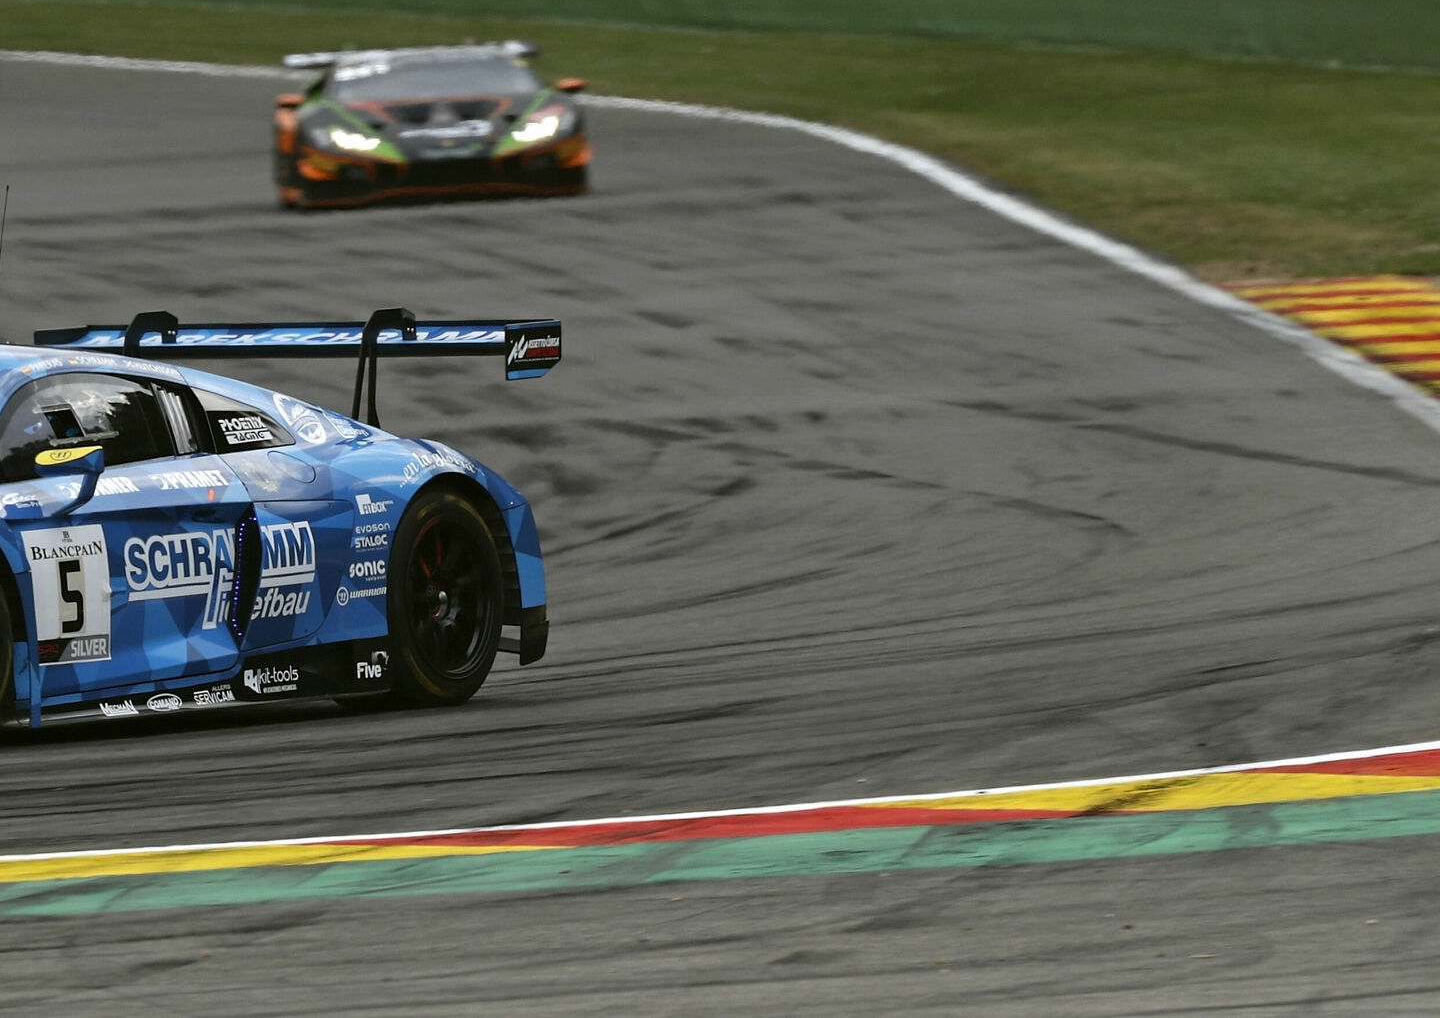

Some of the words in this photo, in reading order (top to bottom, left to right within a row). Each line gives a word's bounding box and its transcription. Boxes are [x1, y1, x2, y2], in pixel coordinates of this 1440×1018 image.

[218, 416, 267, 432] PHOENIX
[169, 469, 230, 489] PRAMET
[30, 540, 104, 561] BLANCPAIN
[354, 534, 388, 549] STALOC
[124, 521, 316, 591] SCHRAMM
[58, 559, 85, 634] 5
[70, 638, 107, 658] SILVER
[356, 661, 382, 679] Five
[193, 689, 236, 706] SERVICAM
